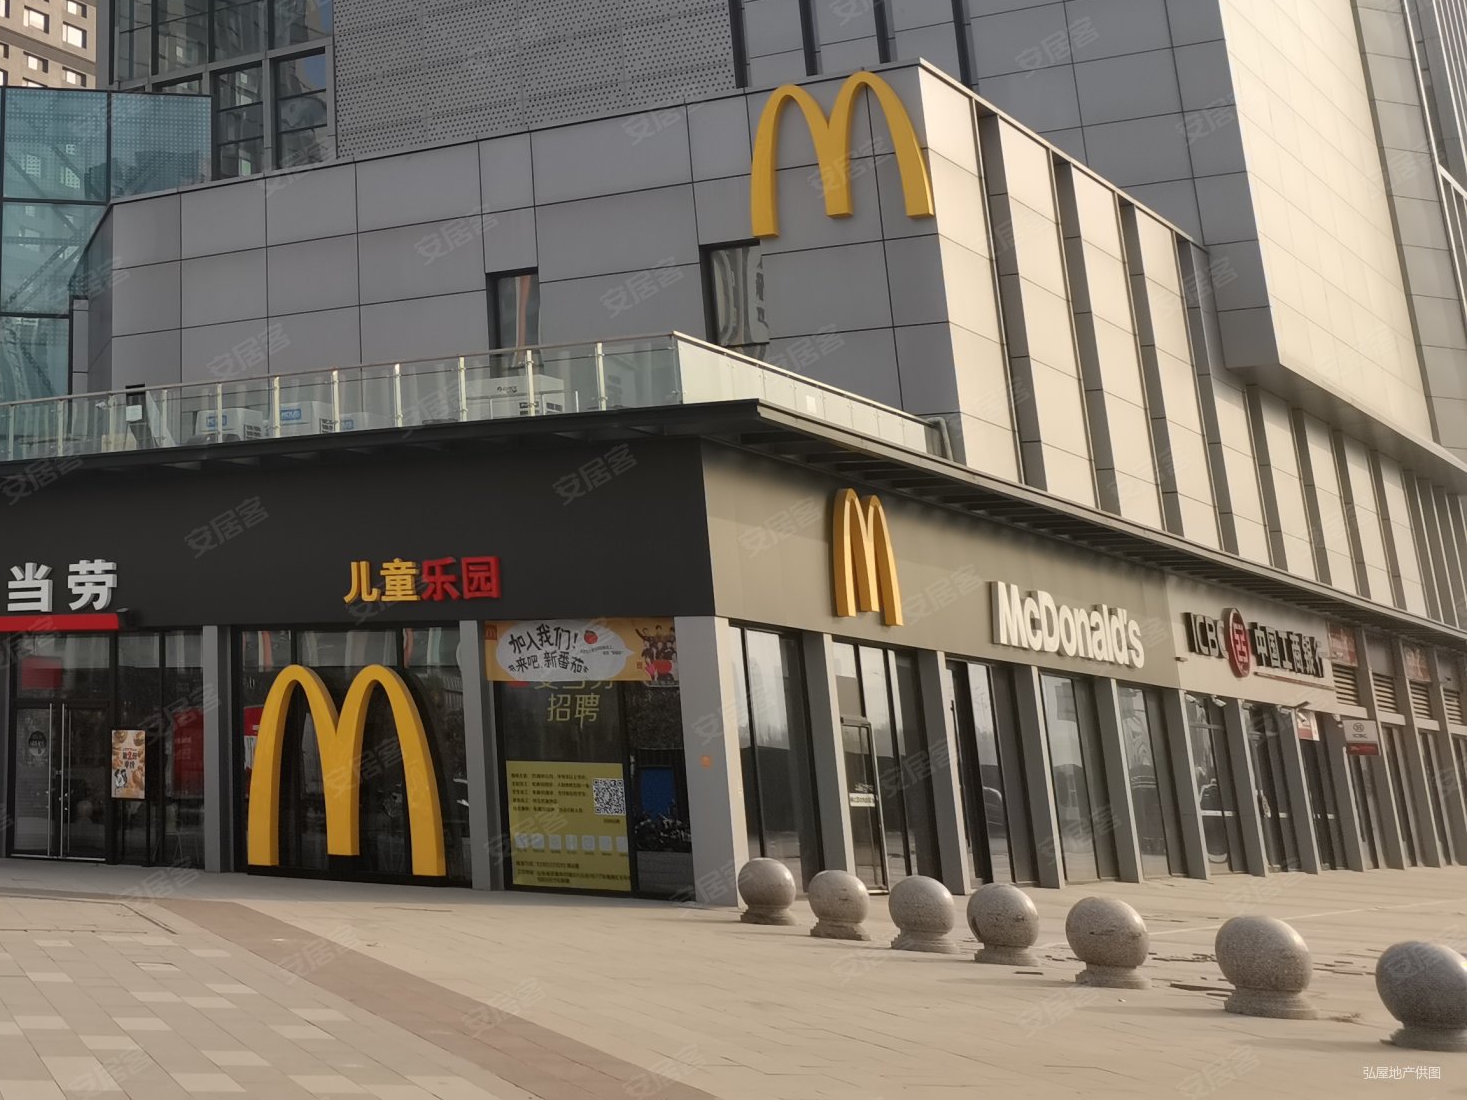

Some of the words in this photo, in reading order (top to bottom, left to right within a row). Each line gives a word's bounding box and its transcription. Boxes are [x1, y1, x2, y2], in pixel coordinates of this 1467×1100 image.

[342, 556, 502, 604] 儿童乐园
[994, 580, 1145, 669] McDonald's
[546, 692, 601, 730] 招聘
